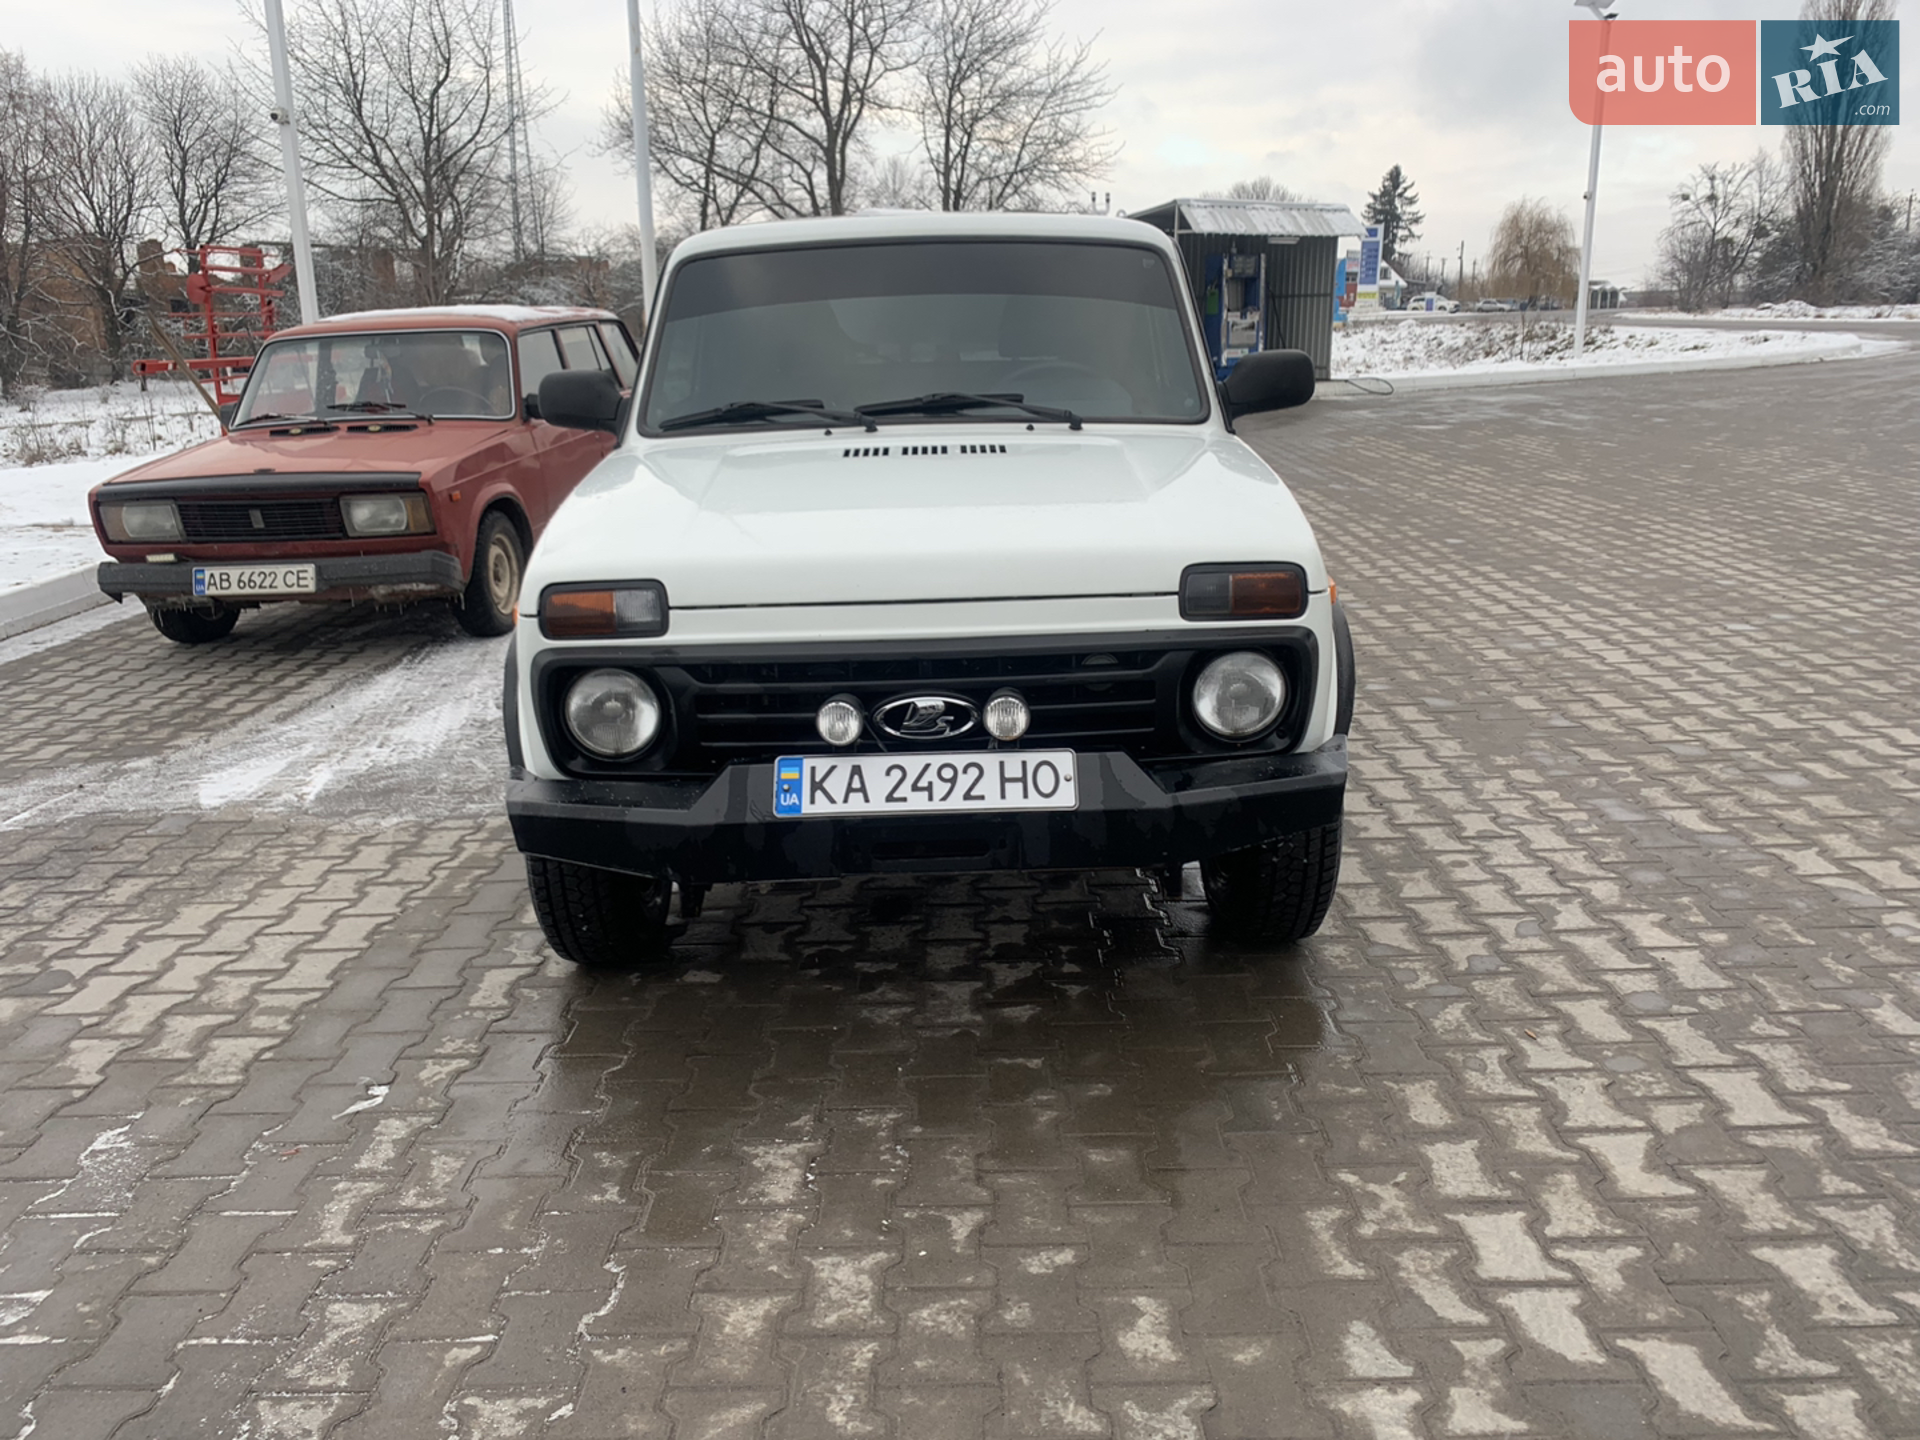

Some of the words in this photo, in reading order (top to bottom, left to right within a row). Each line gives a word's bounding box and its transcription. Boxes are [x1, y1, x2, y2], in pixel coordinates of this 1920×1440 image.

[206, 572, 232, 591] AB
[237, 571, 278, 590] 6622
[283, 569, 309, 588] CE
[808, 764, 870, 805] KA
[884, 761, 986, 803] 2492
[998, 759, 1061, 801] HO
[780, 793, 800, 806] UA
